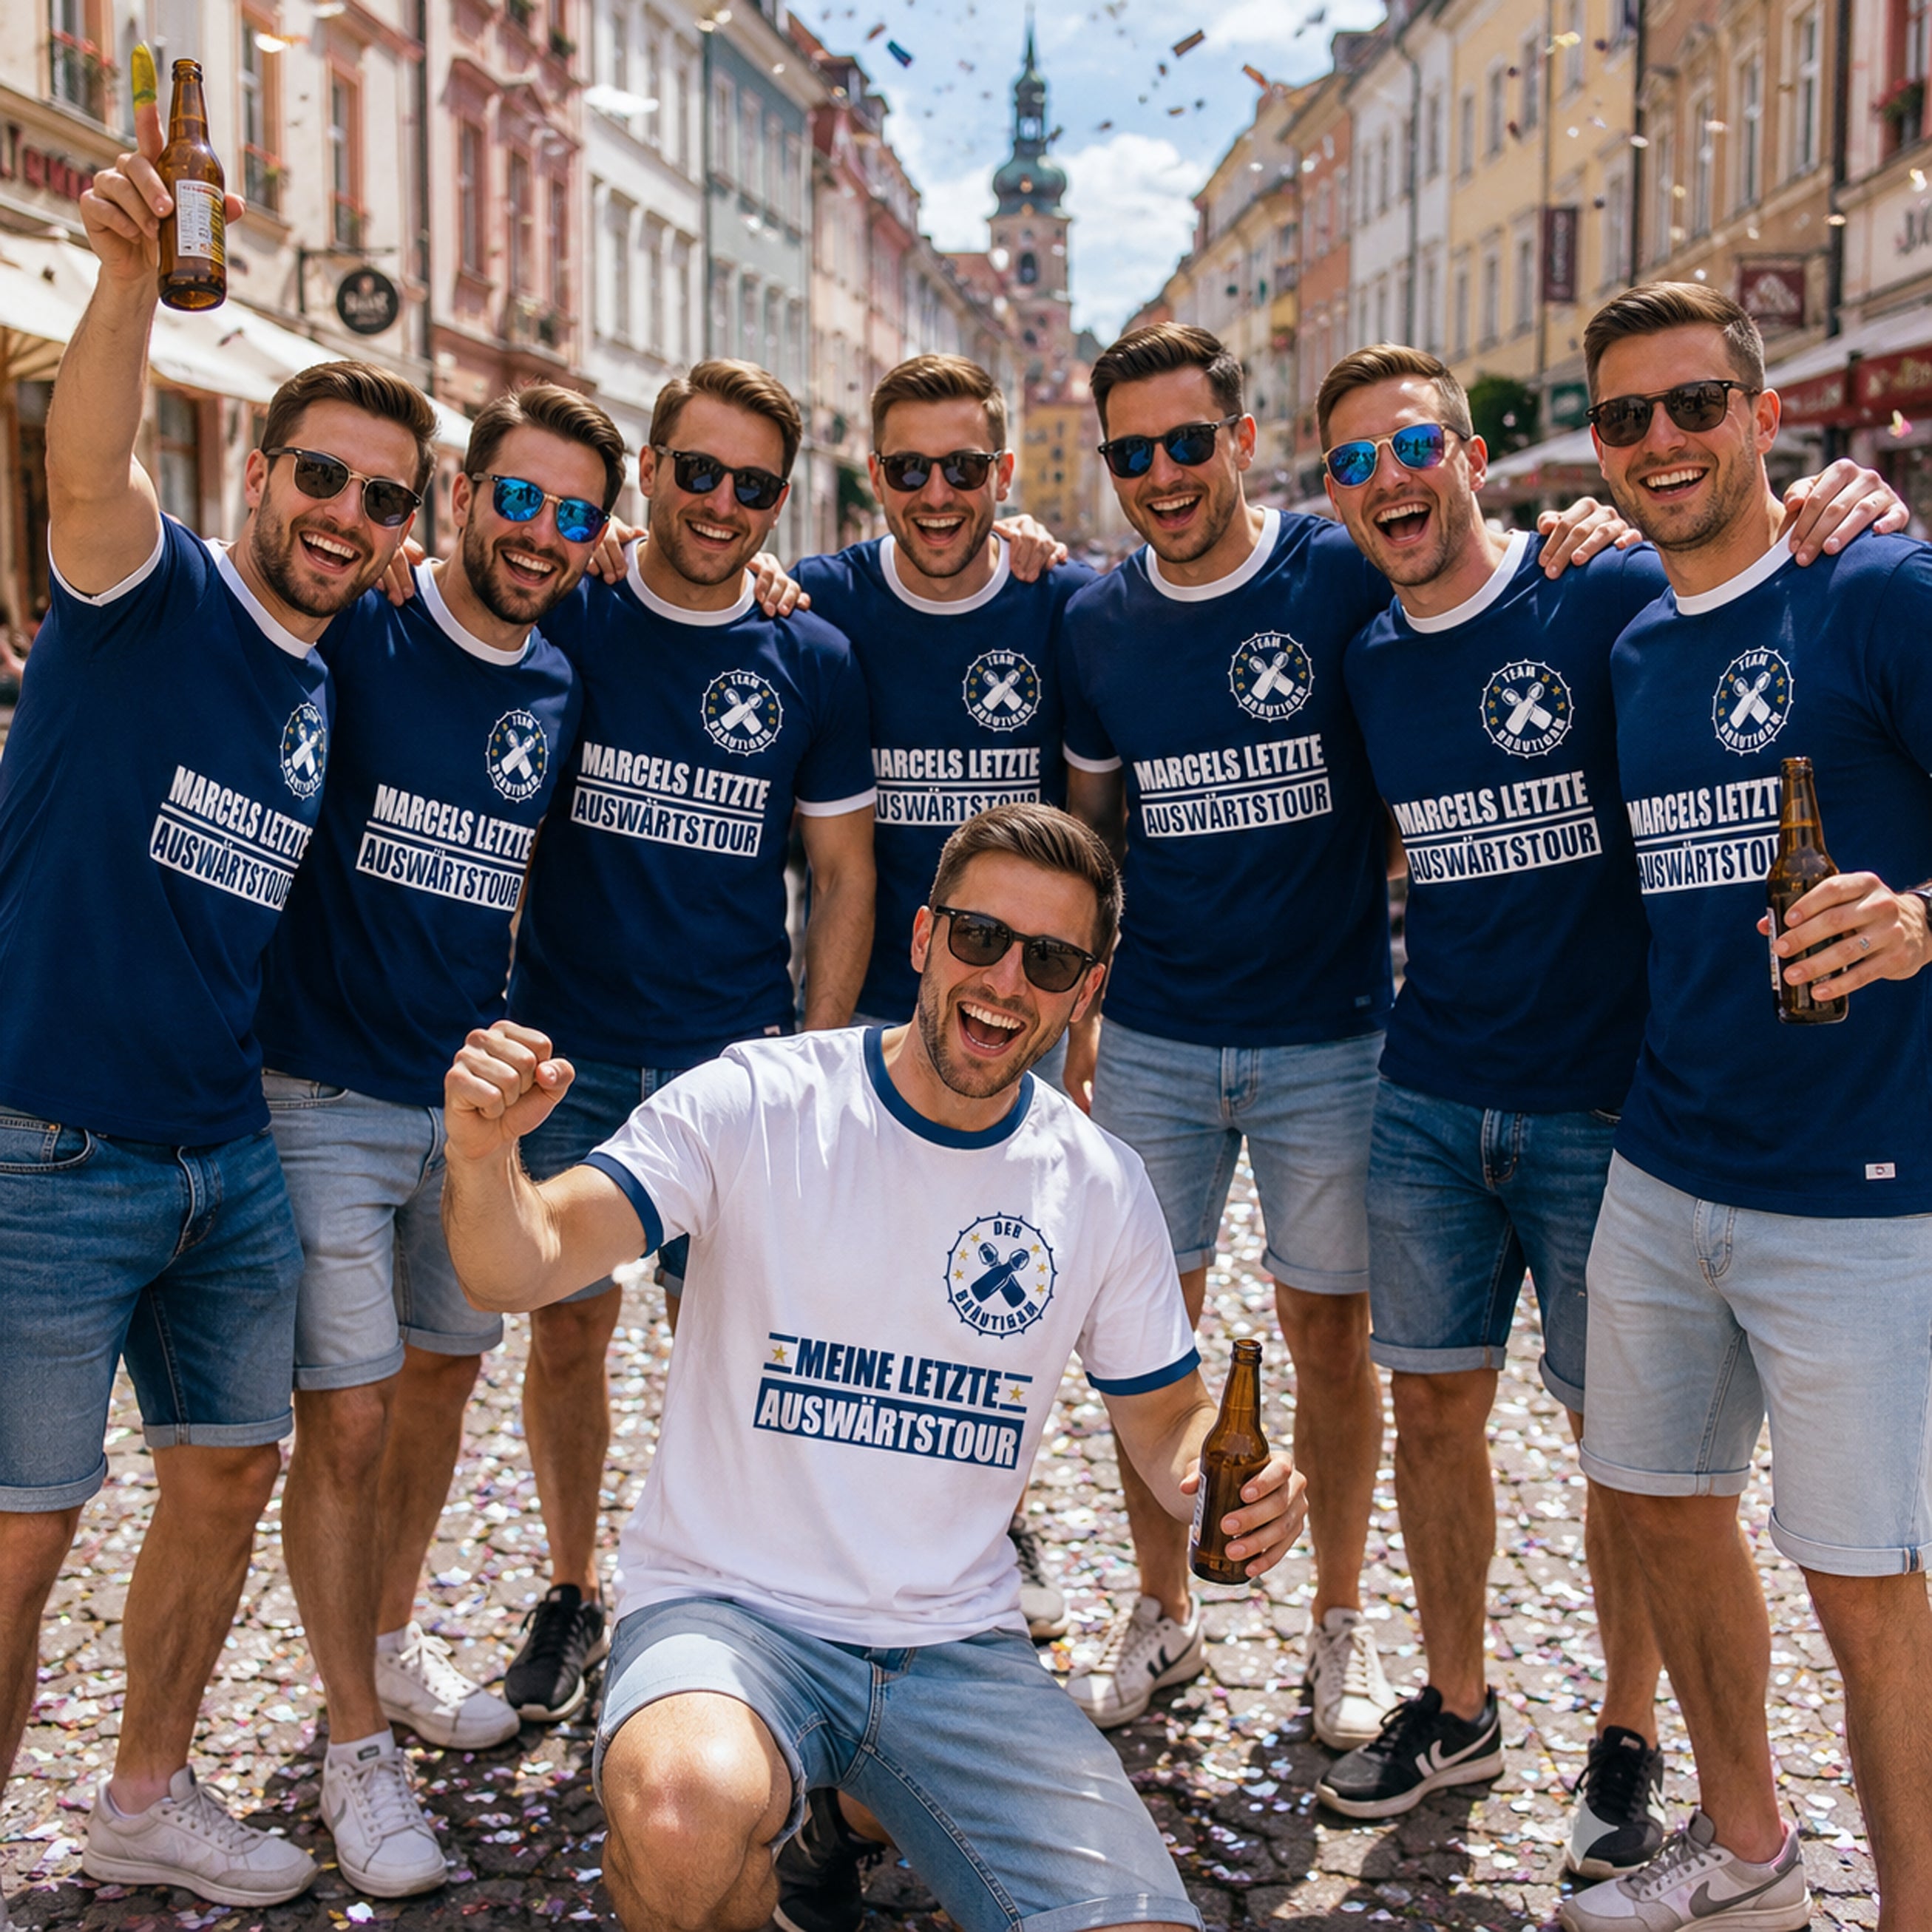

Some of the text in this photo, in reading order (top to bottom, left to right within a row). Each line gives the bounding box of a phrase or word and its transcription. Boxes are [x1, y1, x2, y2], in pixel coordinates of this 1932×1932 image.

[581, 741, 772, 810] MARCELS LETZTE
[969, 748, 1040, 779] LETZTE
[1133, 733, 1324, 792] MARCELS LETZTE
[168, 765, 262, 840] MARCELS
[372, 783, 536, 861] MARCELS LETZTE
[574, 790, 758, 853] AUSWÄRTSTOUR
[1145, 783, 1329, 835] AUSWÄRTSTOUR
[1393, 770, 1589, 835] MARCELS LETZTE
[1626, 776, 1783, 837] MARCELS LETZT
[359, 838, 521, 908] AUSWÄRTSTOUR
[1409, 822, 1597, 881] AUSWÄRTSTOUR
[795, 1338, 1002, 1409] MEINE LETZTE
[757, 1388, 1018, 1466] AUSWÄRTSTOUR
